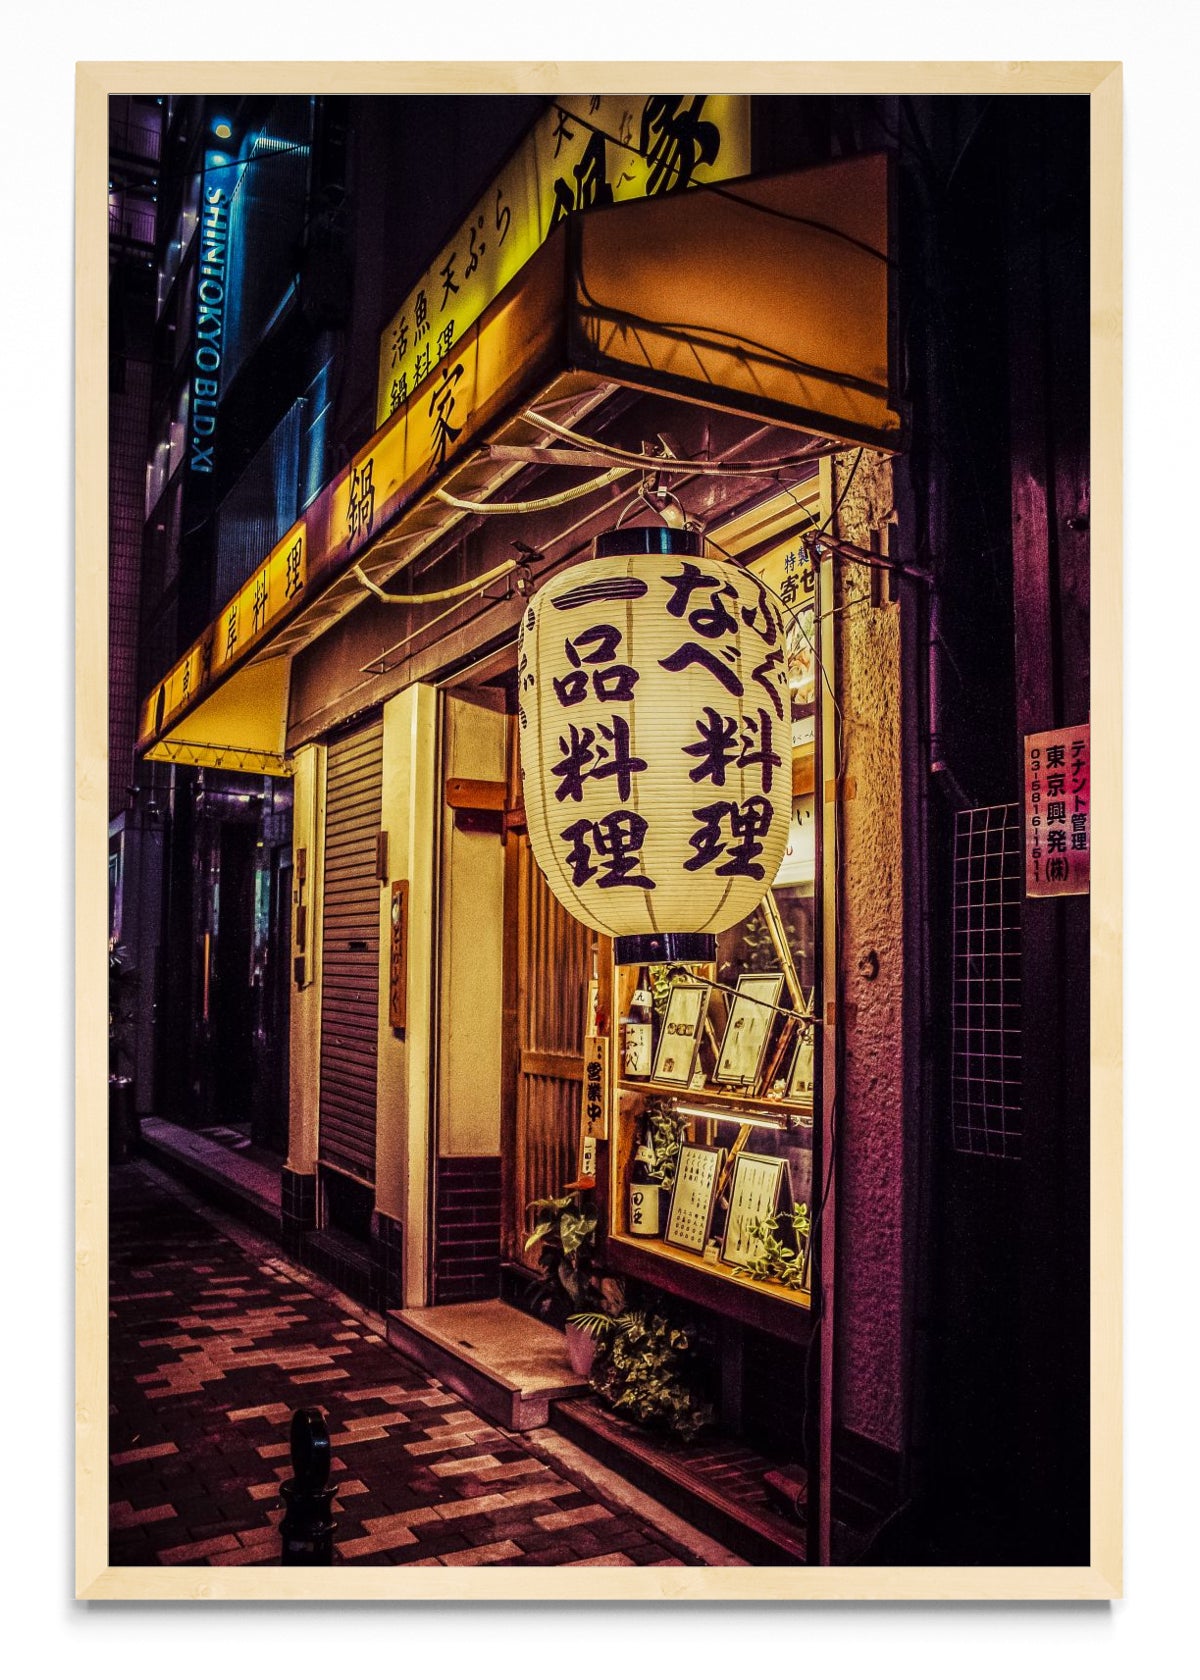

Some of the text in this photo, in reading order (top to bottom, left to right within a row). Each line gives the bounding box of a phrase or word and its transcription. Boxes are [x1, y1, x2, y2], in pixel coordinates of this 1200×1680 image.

[190, 186, 227, 474] SHINTOKYO BLD.XI
[551, 576, 657, 890] 一品料理
[657, 562, 783, 881] なべ料理
[1030, 748, 1041, 882] 03-5816-1511
[1045, 744, 1069, 882] 東京興発(株)
[1070, 740, 1087, 851] テナント管理
